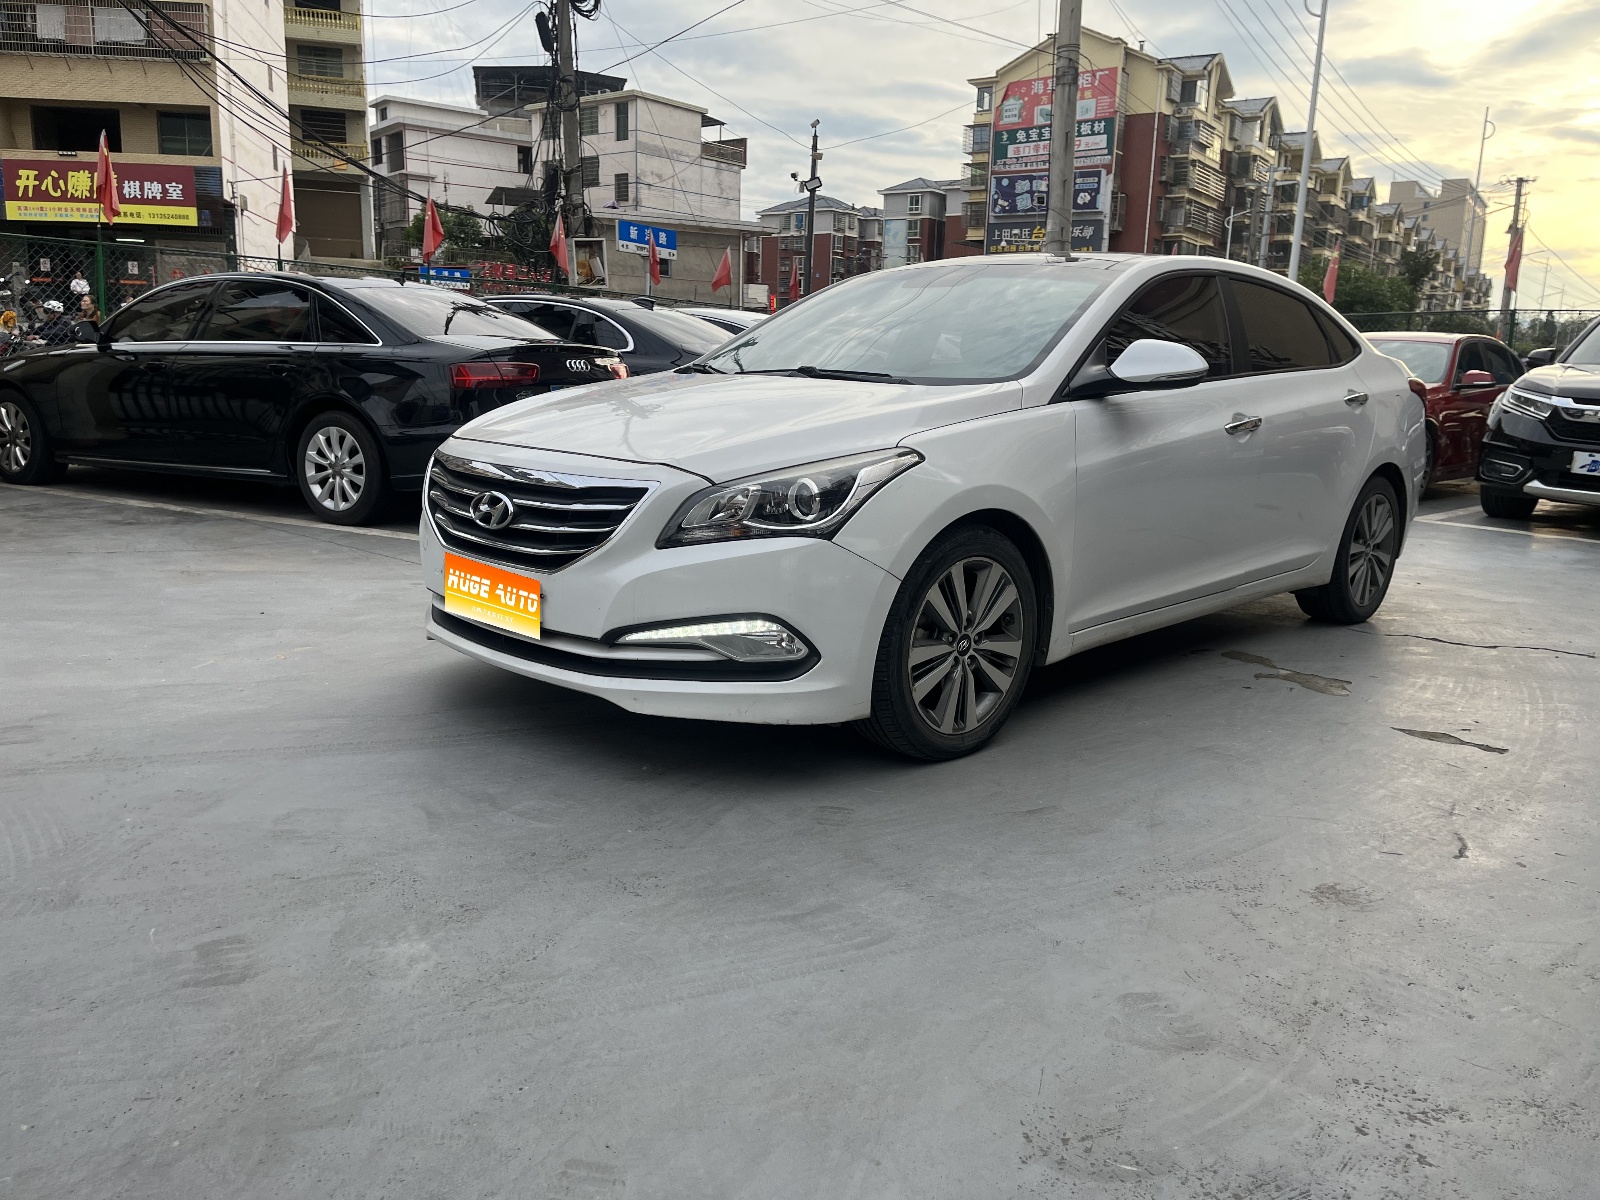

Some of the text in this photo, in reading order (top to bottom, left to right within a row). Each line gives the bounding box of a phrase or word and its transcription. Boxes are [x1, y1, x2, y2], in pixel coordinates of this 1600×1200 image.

[15, 169, 184, 200] 开心赚 棋牌室
